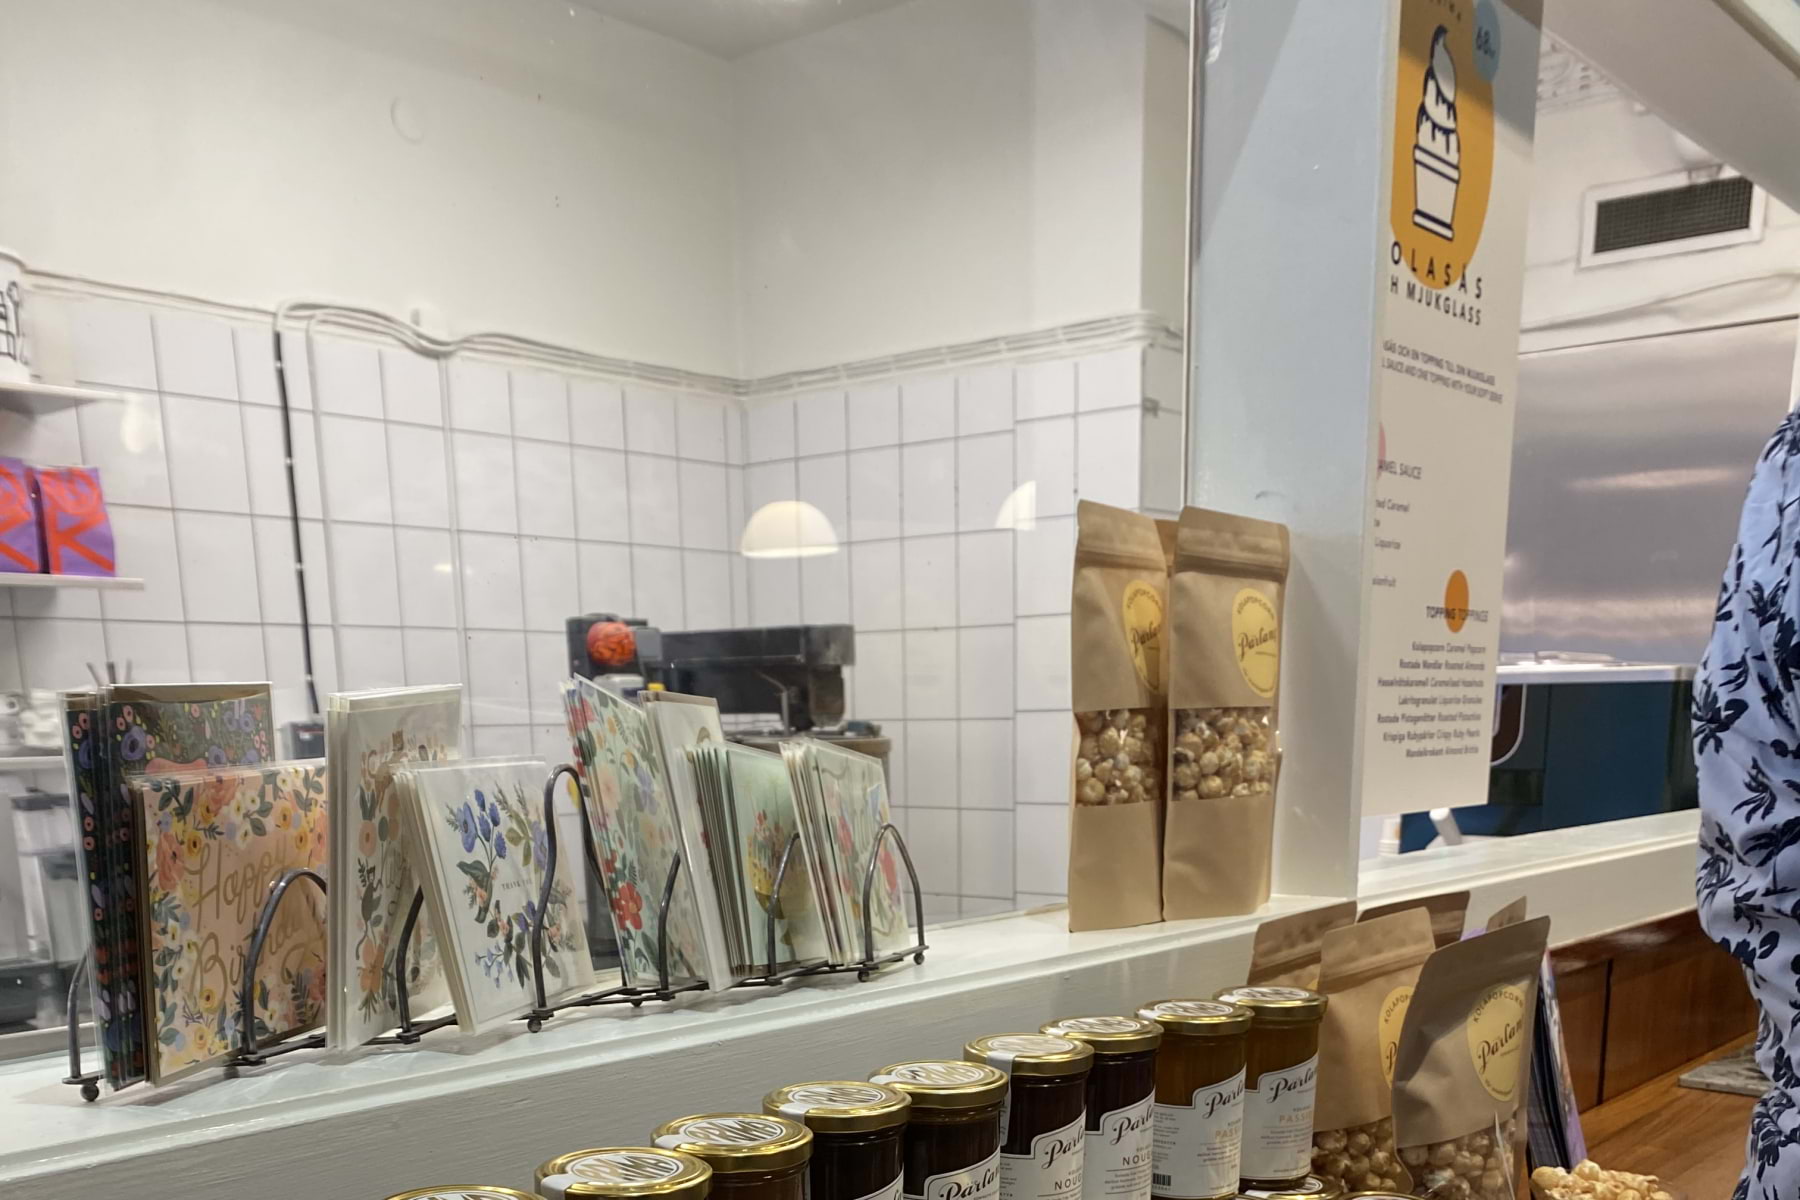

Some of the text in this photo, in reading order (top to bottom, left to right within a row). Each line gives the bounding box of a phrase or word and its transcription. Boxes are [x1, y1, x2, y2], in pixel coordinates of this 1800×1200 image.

[1406, 281, 1482, 326] MJUKGLASS
[1400, 464, 1422, 480] SAUCE
[180, 836, 289, 921] Happy
[189, 913, 324, 1010] Birday
